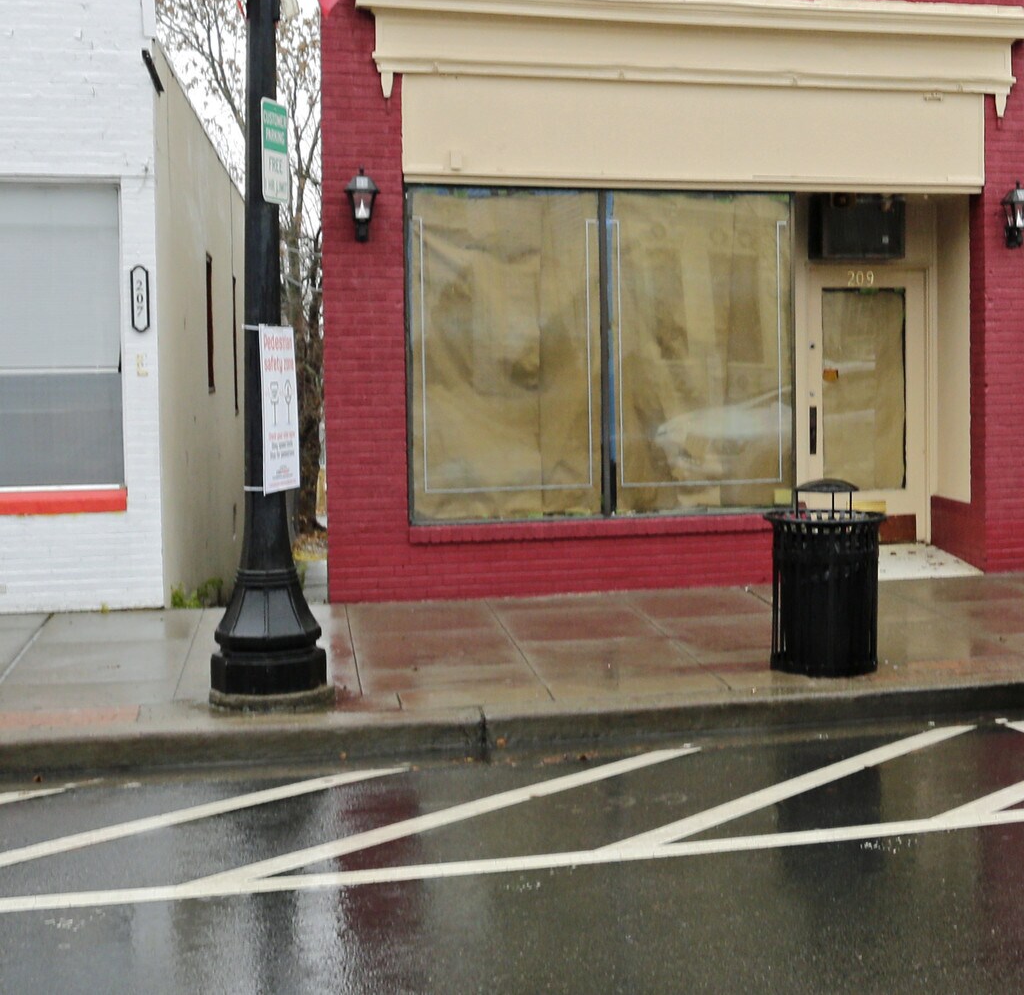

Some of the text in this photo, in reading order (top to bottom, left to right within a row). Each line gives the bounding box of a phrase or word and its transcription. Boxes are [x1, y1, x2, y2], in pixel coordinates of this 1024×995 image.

[268, 156, 283, 175] FREE
[847, 270, 874, 287] 209
[136, 279, 144, 317] 207
